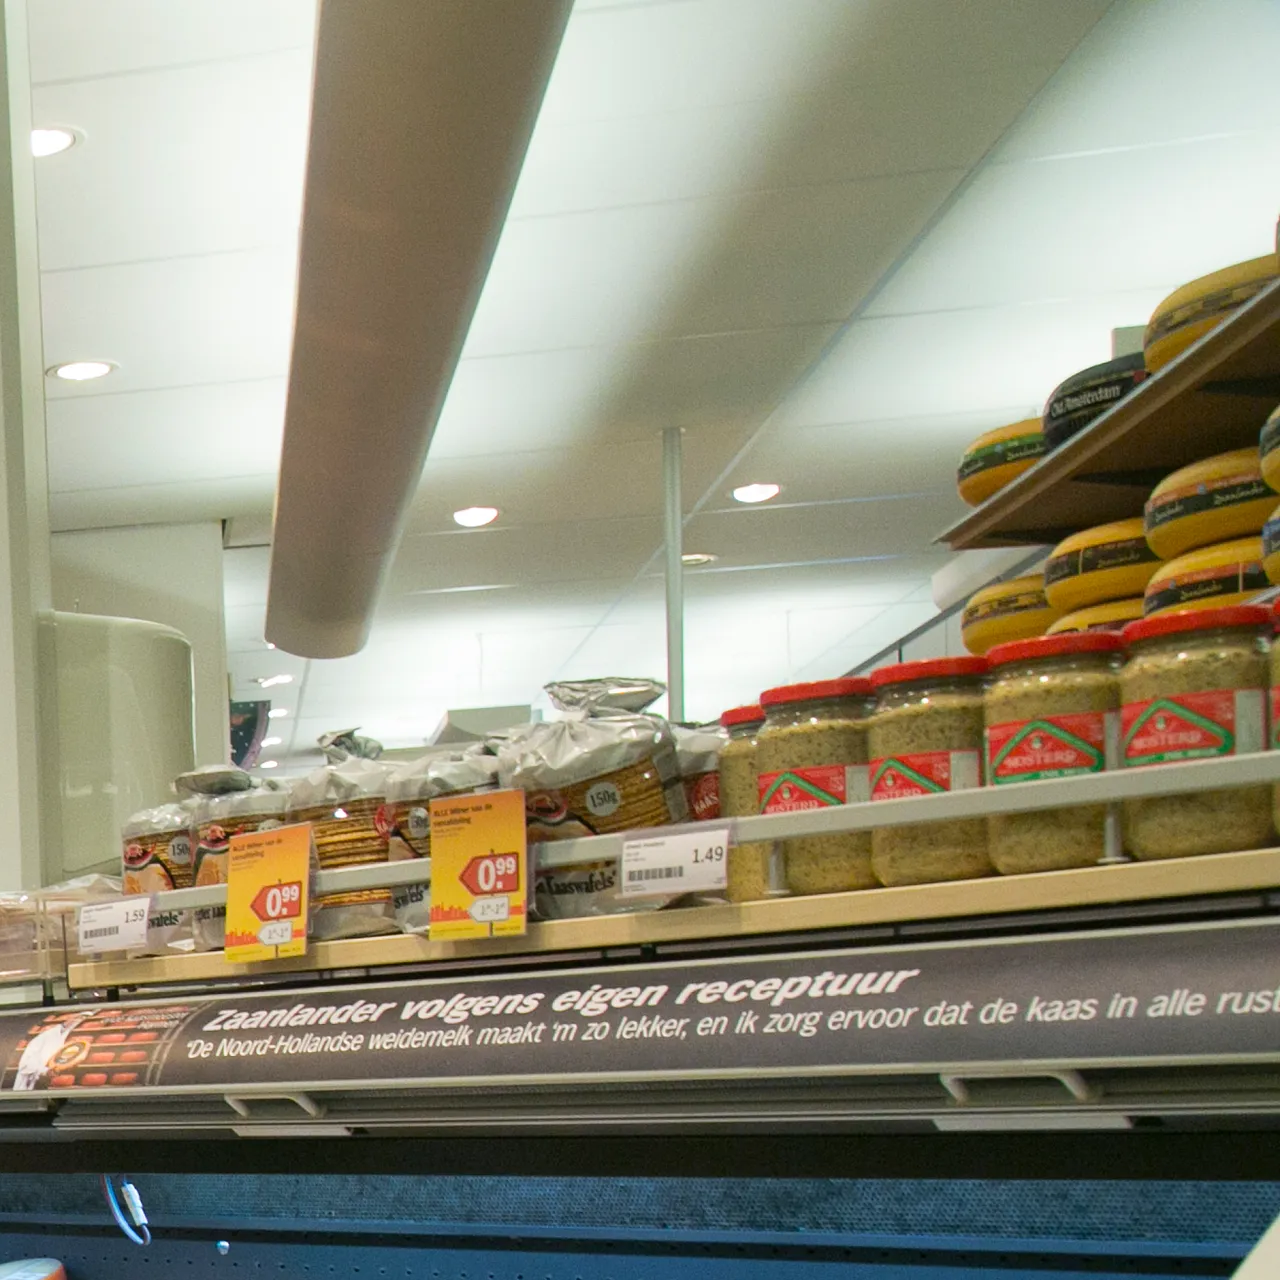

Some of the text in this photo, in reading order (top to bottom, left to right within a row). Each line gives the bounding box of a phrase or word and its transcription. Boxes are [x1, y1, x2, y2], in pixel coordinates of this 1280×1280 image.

[590, 791, 618, 808] 150g
[692, 846, 723, 864] 1.49
[477, 856, 517, 890] 0.99
[124, 908, 145, 925] 1.59
[266, 884, 299, 917] 0.99
[203, 999, 395, 1032] Zaanlander
[400, 990, 545, 1024] volgens
[552, 984, 669, 1017] eigen
[675, 968, 921, 1007] receptuur
[216, 1032, 364, 1059] Noord-Hollandse
[368, 1021, 473, 1050] weidemelk
[476, 1021, 547, 1046] maakt
[581, 1021, 610, 1042] zo
[616, 1015, 690, 1041] lekker,
[696, 1015, 728, 1036] en
[734, 1010, 758, 1035] ik
[763, 1010, 822, 1038] zorg
[827, 1004, 919, 1032] ervoor
[923, 999, 974, 1028] dat
[979, 997, 1018, 1024] de
[1024, 995, 1099, 1023] kaas
[1106, 992, 1139, 1019] in
[1146, 988, 1207, 1018] alle
